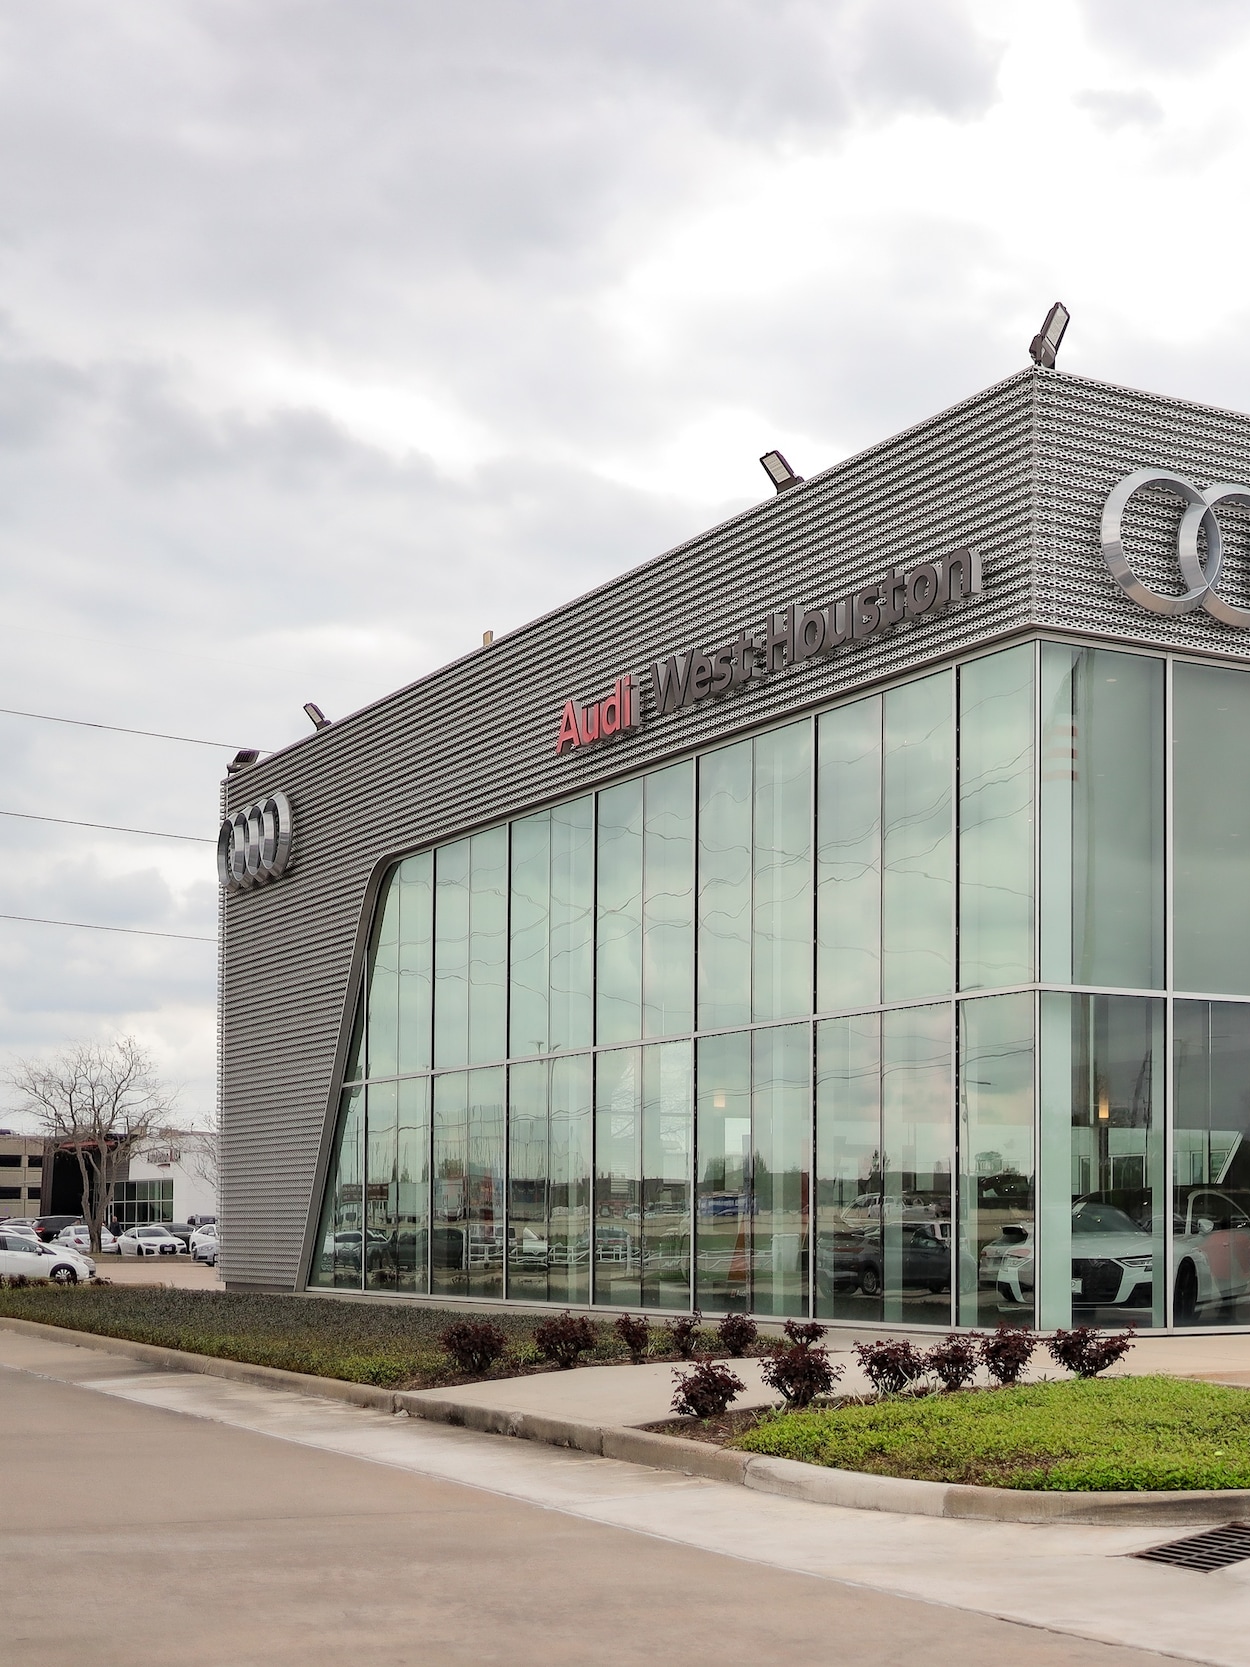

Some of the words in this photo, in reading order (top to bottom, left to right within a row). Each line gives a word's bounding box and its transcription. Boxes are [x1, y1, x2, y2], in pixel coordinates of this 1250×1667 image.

[556, 675, 639, 755] Audi
[650, 632, 766, 715] West
[766, 549, 981, 672] Houston
